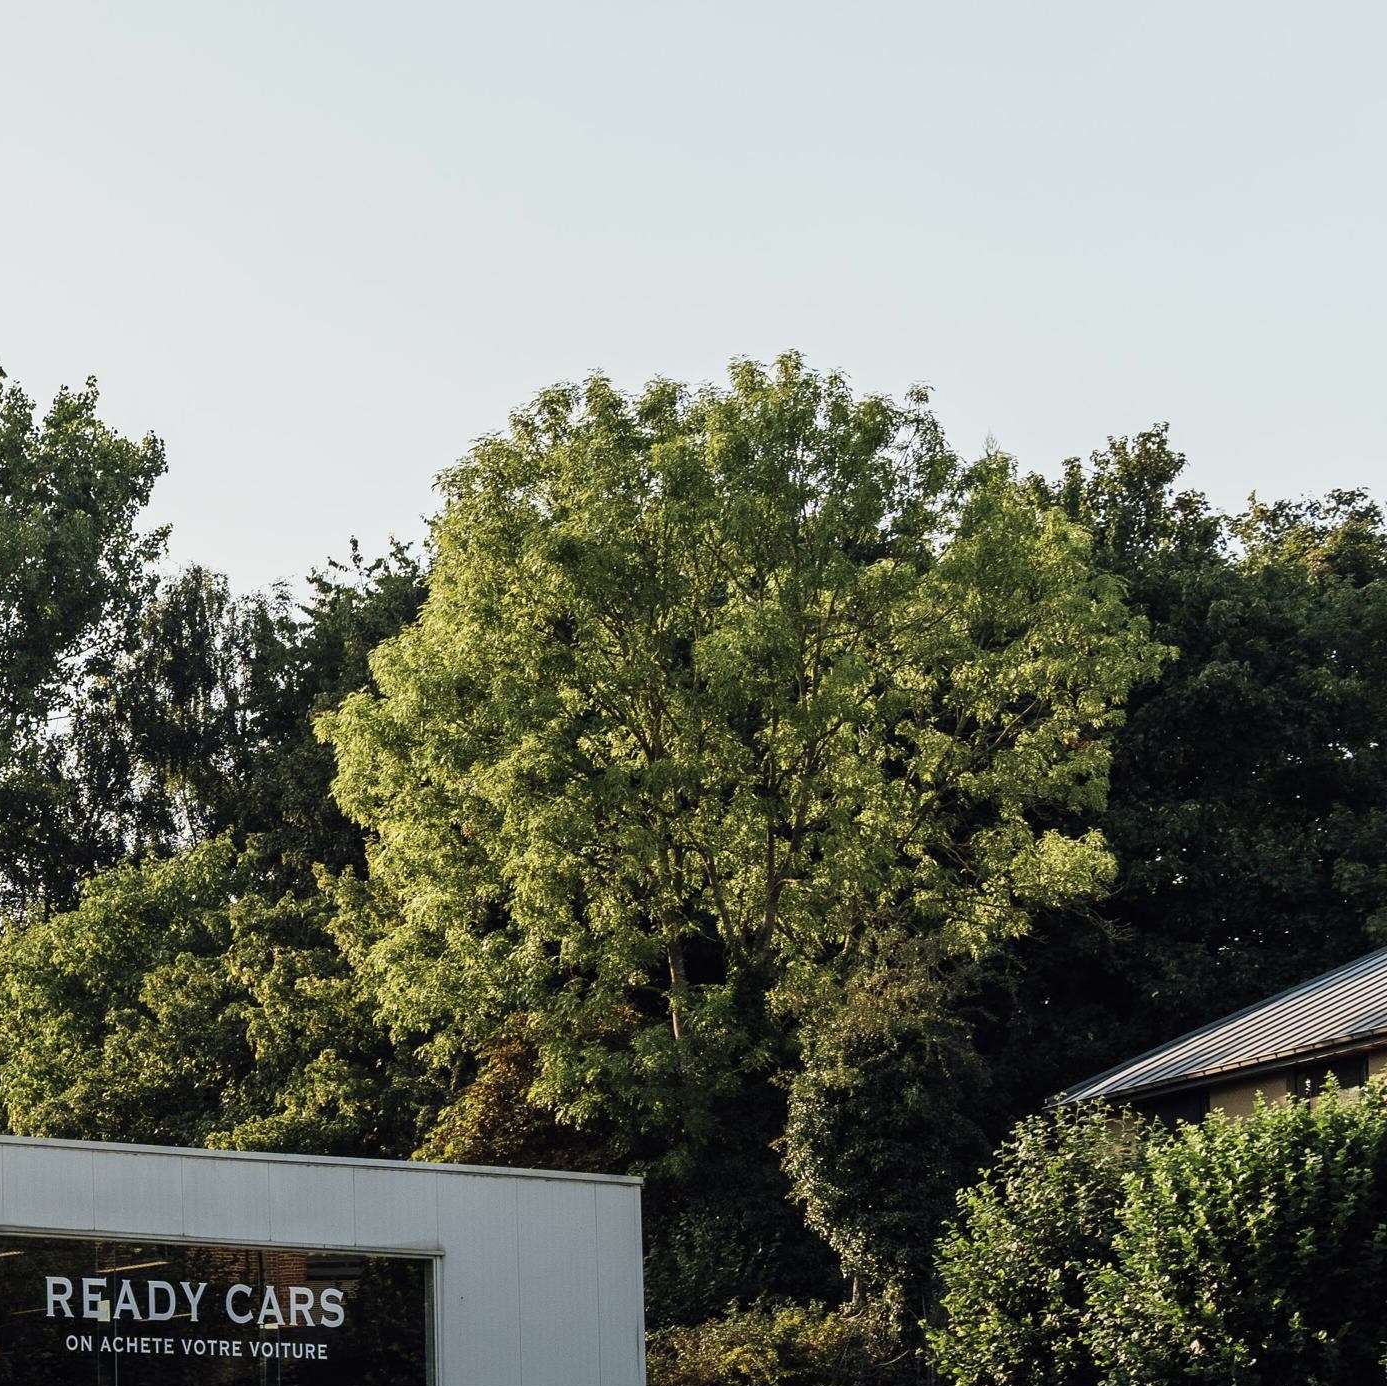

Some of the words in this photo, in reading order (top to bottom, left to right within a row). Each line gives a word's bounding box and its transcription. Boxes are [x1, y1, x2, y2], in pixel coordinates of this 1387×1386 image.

[45, 1276, 208, 1323] READY
[226, 1283, 345, 1328] CARS
[66, 1335, 92, 1351] ON
[100, 1336, 174, 1355] ACHETE
[181, 1339, 243, 1357] VOTRE
[249, 1341, 328, 1360] VOITURE
